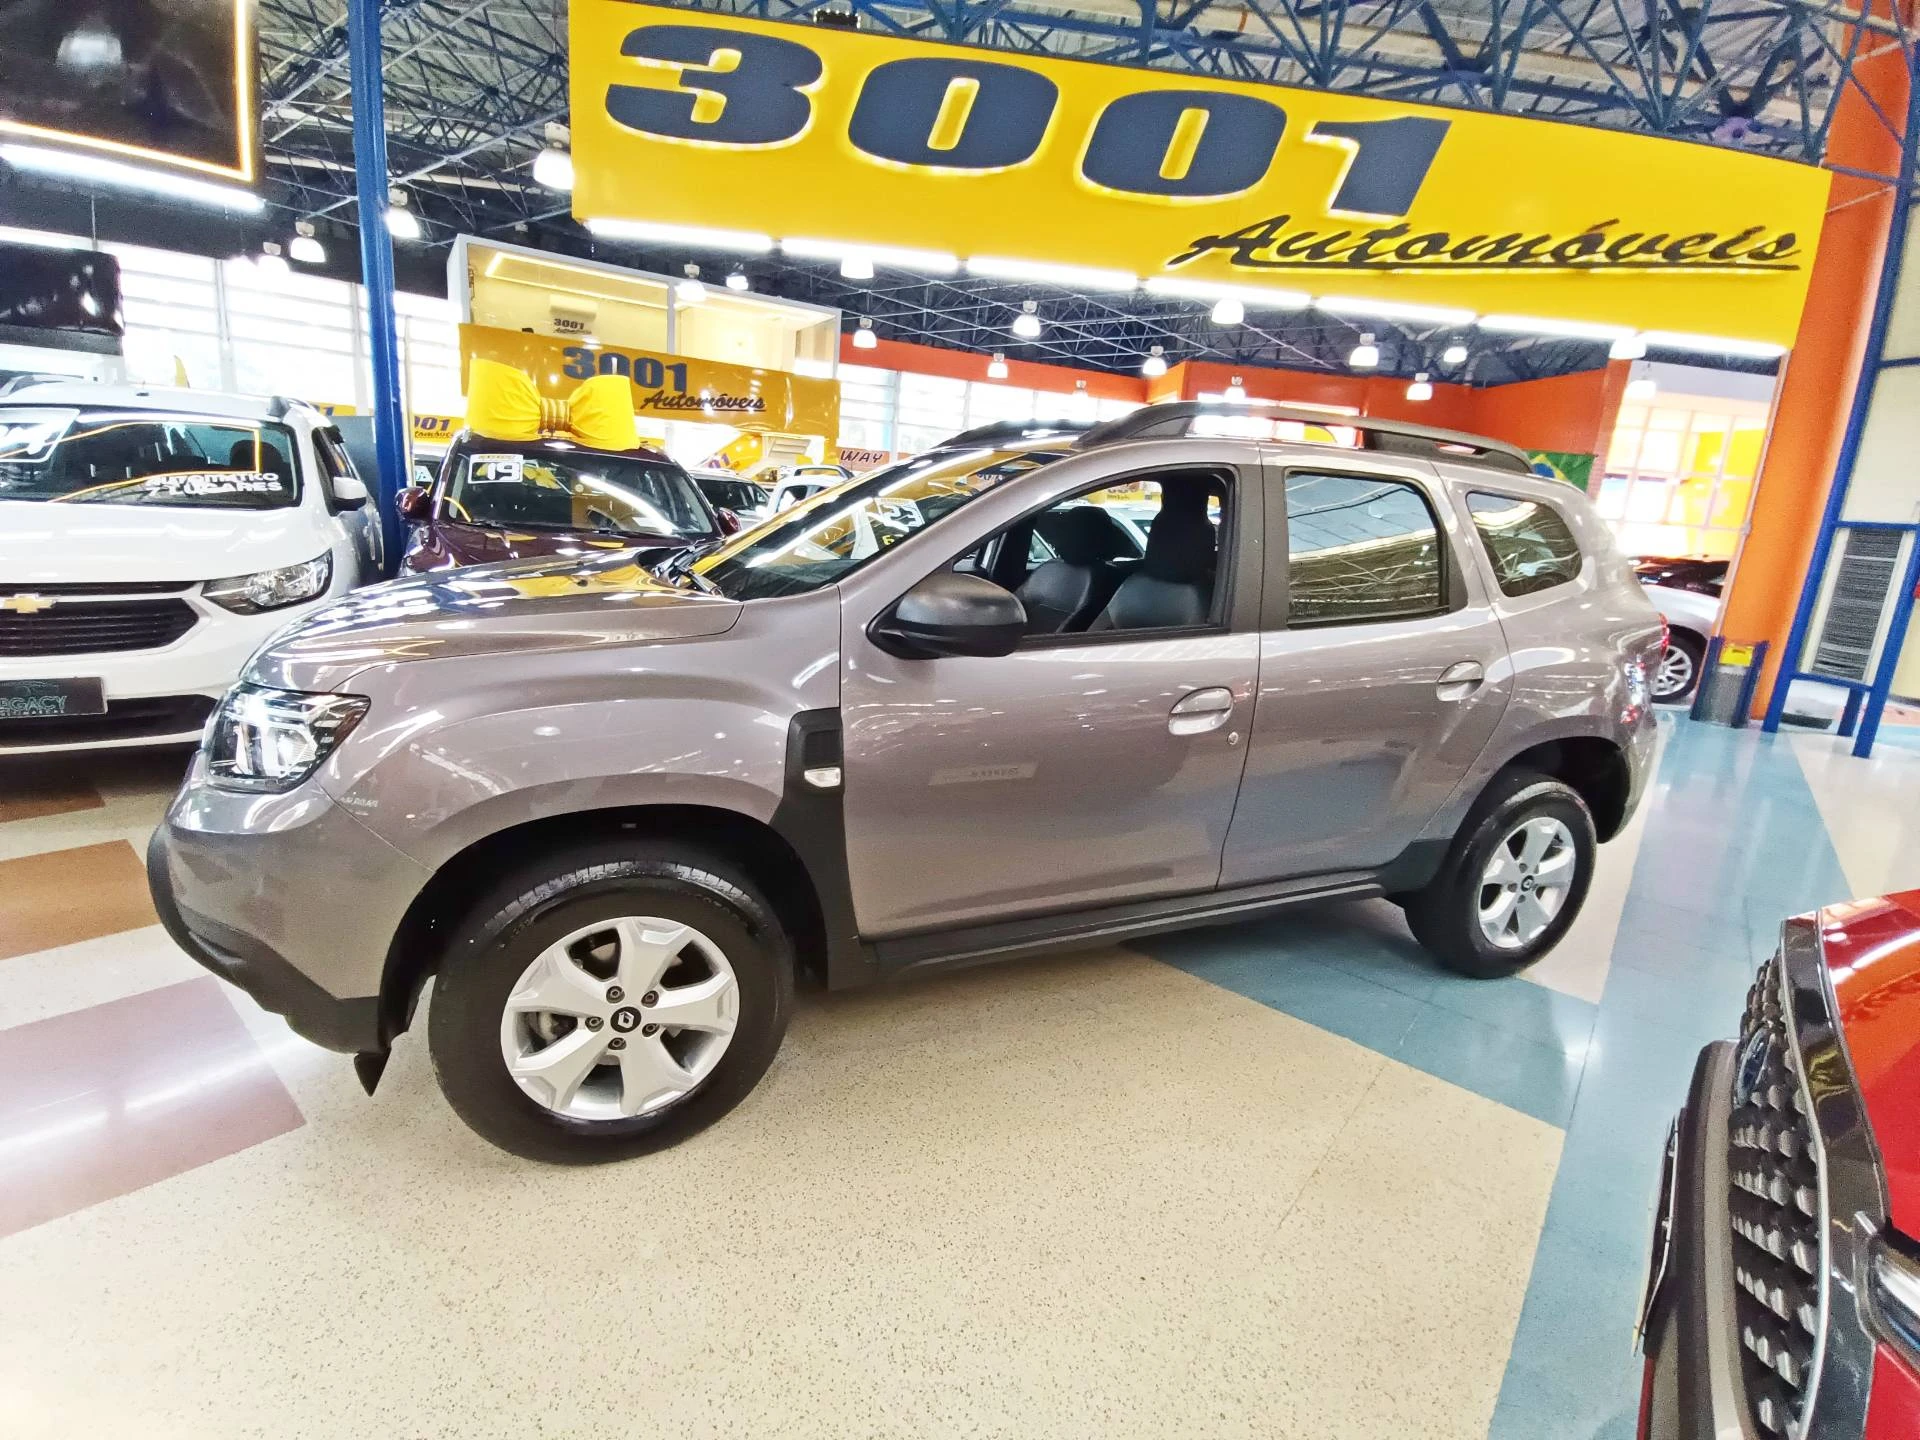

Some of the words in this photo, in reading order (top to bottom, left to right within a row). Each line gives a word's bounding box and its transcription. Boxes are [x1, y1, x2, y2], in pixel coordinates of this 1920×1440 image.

[605, 25, 1452, 217] 3001
[1166, 214, 1801, 271] Automóveis
[563, 346, 687, 392] 3001
